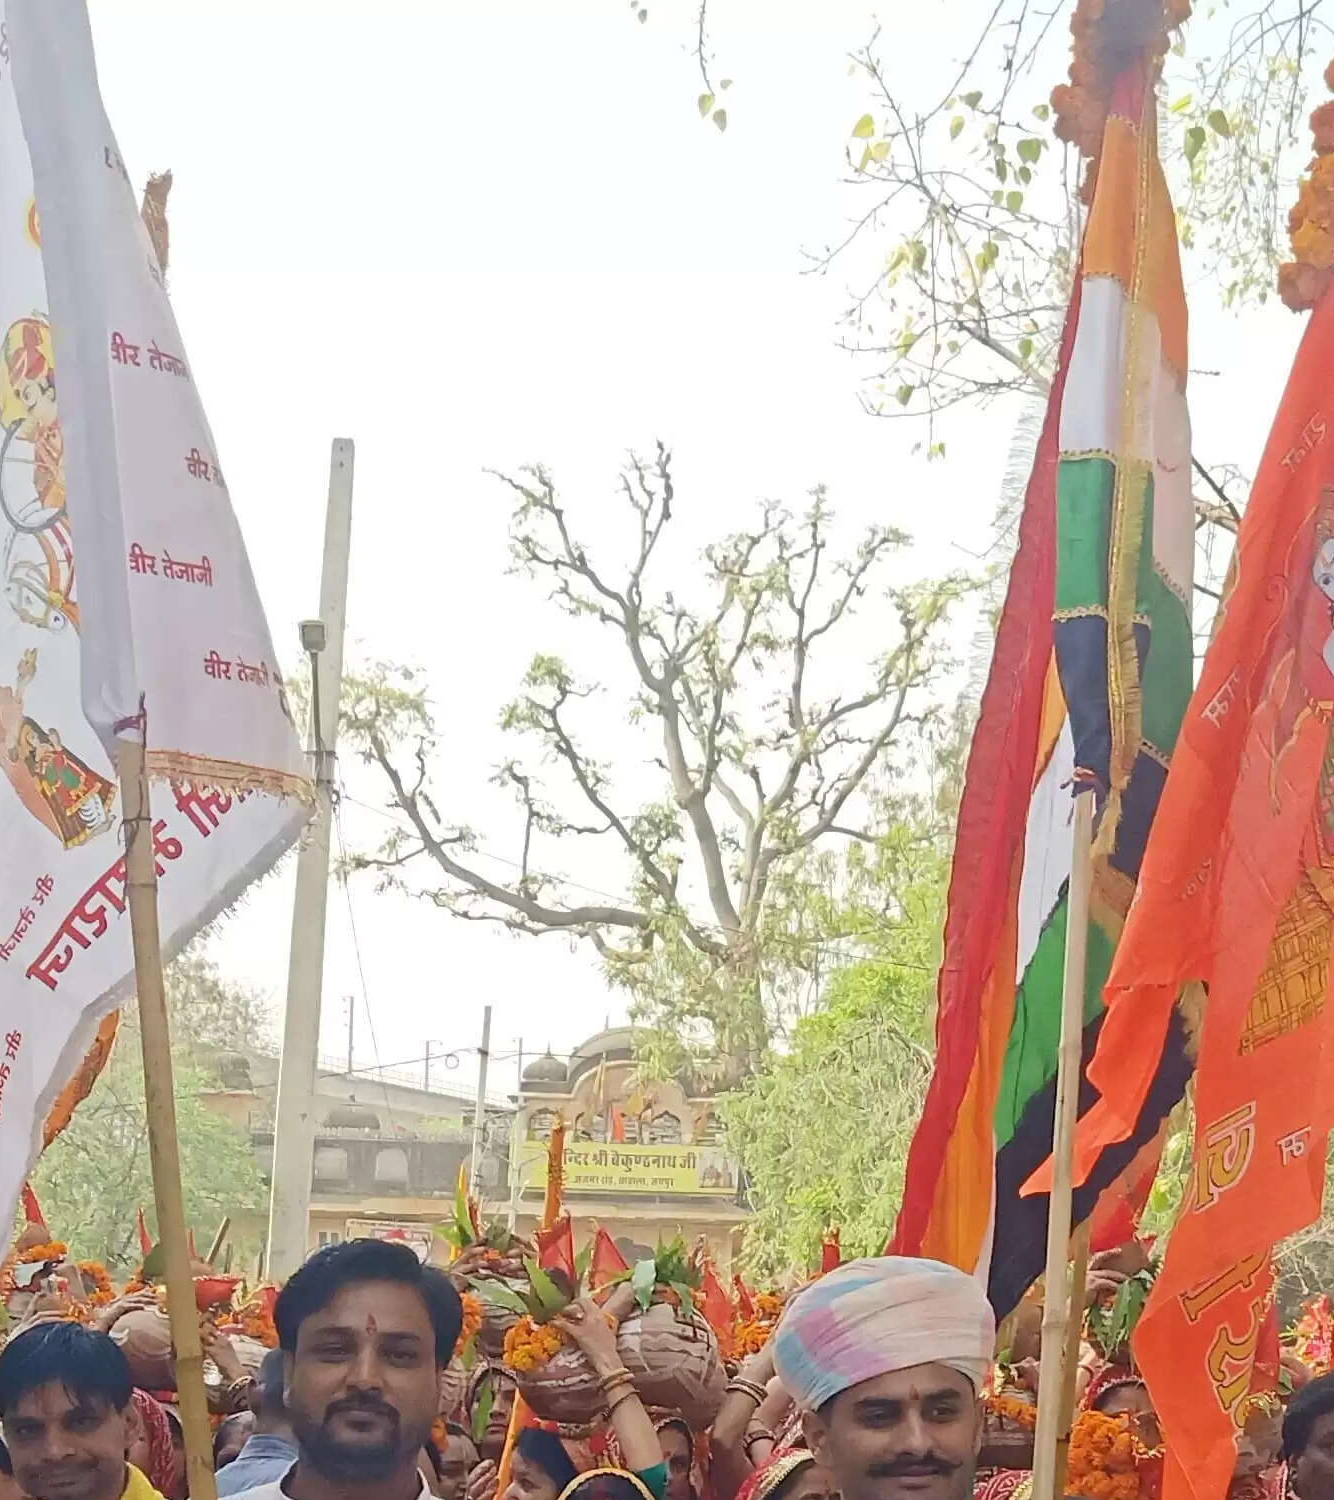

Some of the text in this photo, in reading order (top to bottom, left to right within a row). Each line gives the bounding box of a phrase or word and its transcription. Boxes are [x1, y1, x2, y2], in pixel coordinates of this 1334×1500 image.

[162, 550, 214, 588] तेजाजी
[204, 650, 232, 681] वीर
[563, 1148, 589, 1166] न्दिर
[592, 1149, 608, 1167] श्री
[679, 1152, 697, 1169] जी
